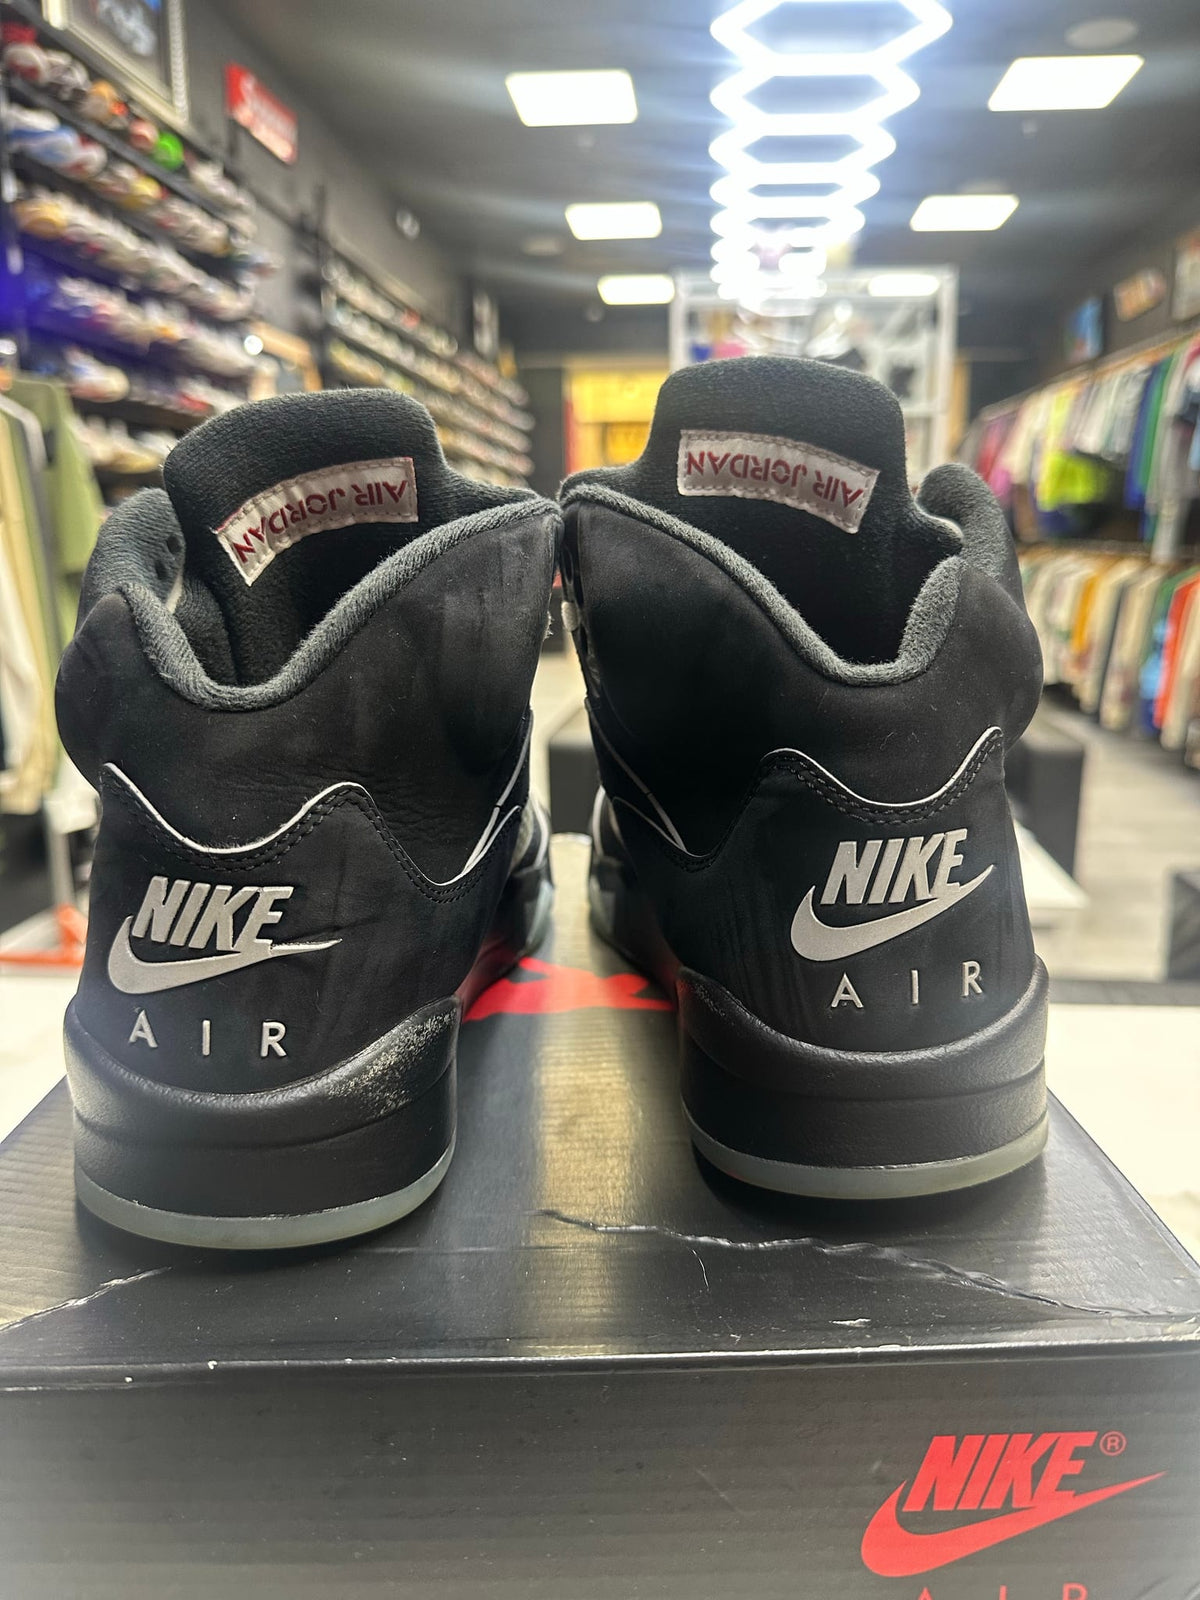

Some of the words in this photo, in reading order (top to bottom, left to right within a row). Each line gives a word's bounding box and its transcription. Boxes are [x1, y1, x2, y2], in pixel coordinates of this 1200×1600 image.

[351, 479, 409, 507] AIR
[686, 450, 808, 488] JORDAN
[812, 470, 864, 508] AIR
[232, 487, 346, 564] JORDAN
[820, 828, 968, 905] NIKE
[131, 875, 294, 952] NIKE
[830, 960, 983, 1008] AIR
[128, 1009, 288, 1057] AIR
